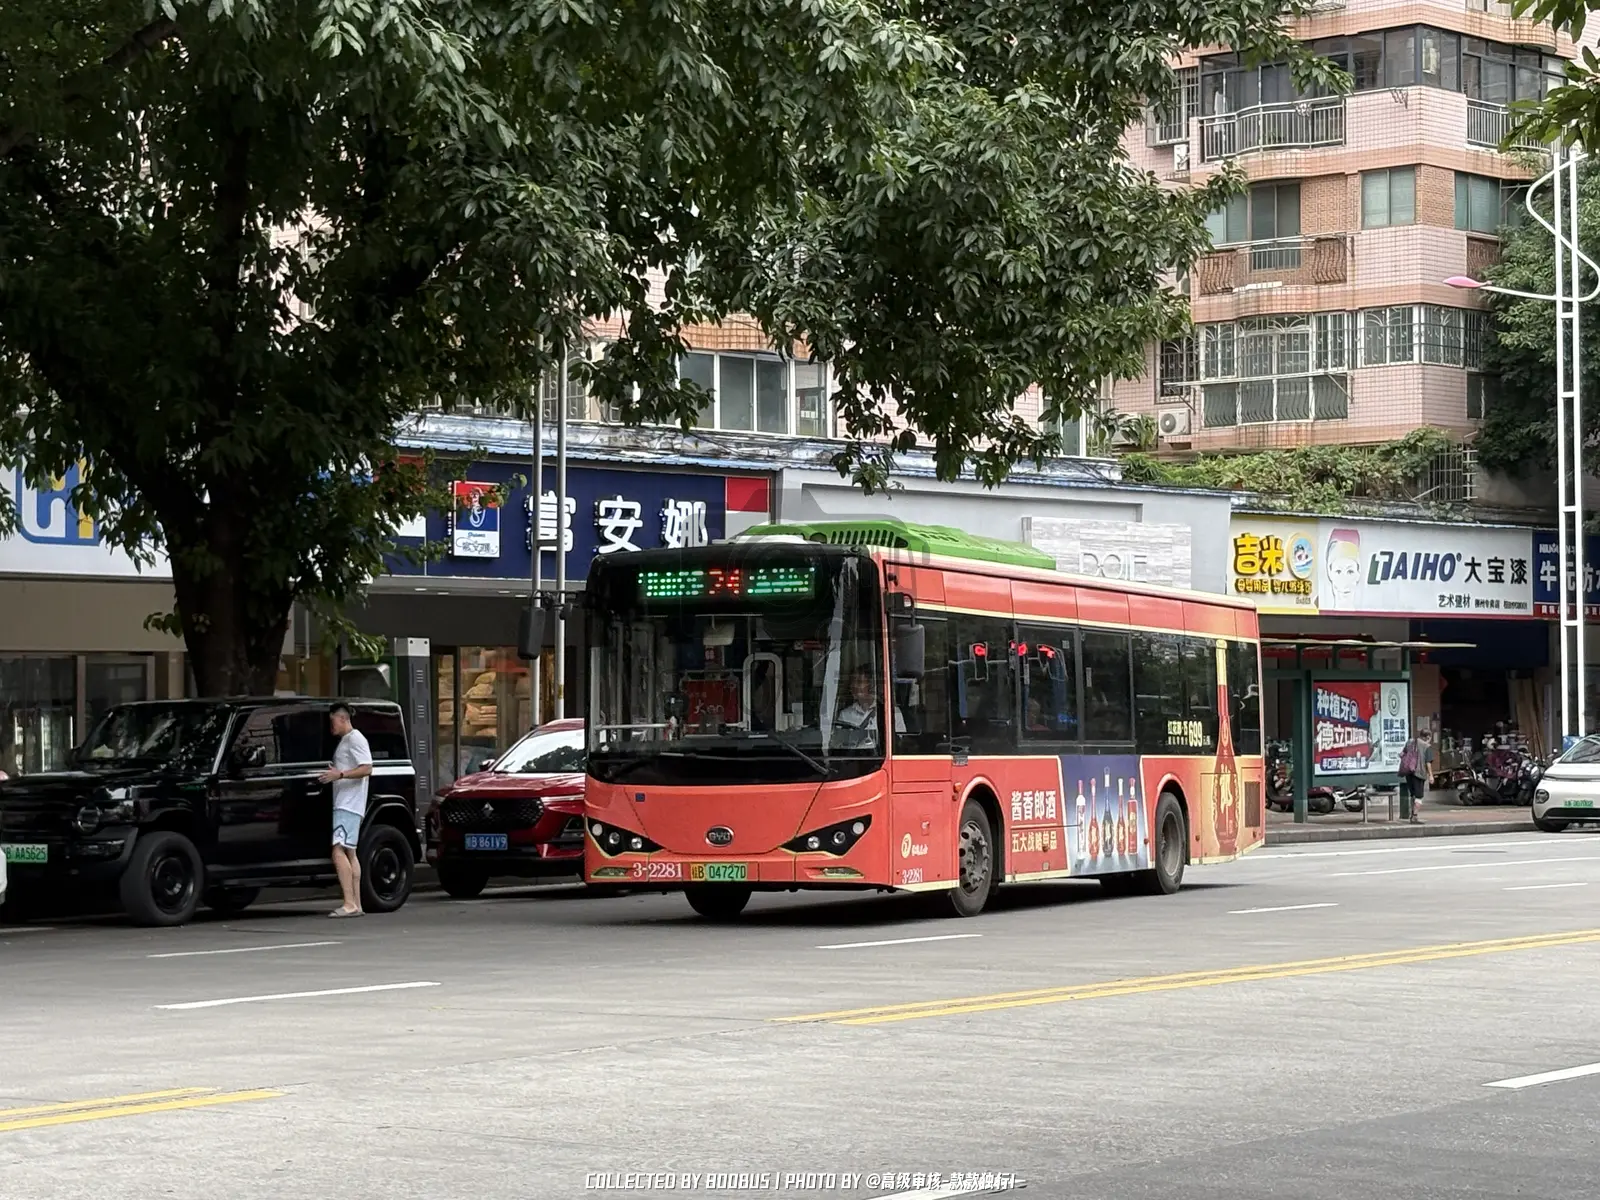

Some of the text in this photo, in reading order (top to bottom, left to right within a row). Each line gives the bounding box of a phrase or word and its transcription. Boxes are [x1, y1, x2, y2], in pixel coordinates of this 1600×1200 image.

[528, 490, 708, 553] 富安娜
[1234, 533, 1284, 577] 吉米
[1464, 556, 1528, 585] 大宝漆
[1189, 720, 1203, 747] 699
[1011, 790, 1056, 821] 酱香郎酒
[1012, 831, 1057, 853] 五大战略单品
[633, 862, 683, 878] 3-2281
[902, 867, 923, 885] 3-2281
